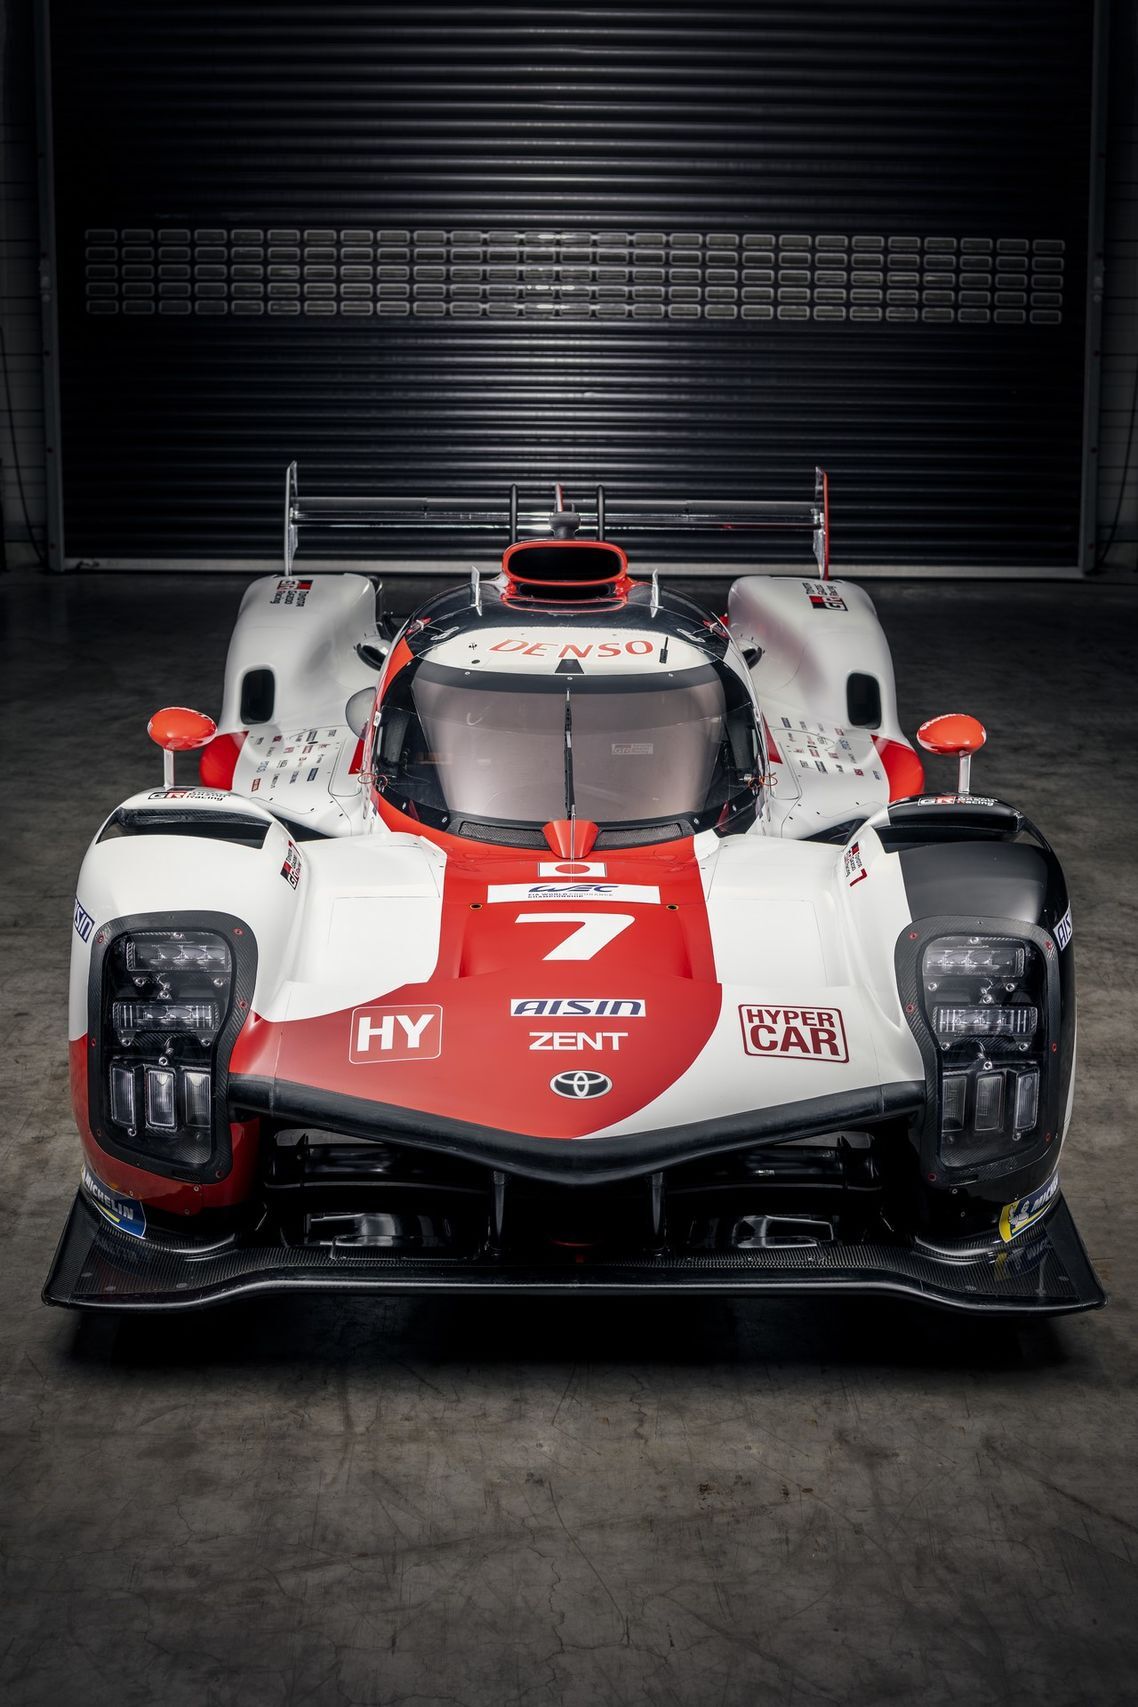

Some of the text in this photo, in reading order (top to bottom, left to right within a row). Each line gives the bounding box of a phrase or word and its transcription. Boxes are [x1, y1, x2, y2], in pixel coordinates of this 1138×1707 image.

[489, 639, 654, 658] DENSO
[528, 884, 619, 893] WEC
[514, 912, 636, 961] 7
[513, 999, 642, 1015] AISIN
[746, 1008, 836, 1028] HYPER
[356, 1013, 435, 1052] HY
[528, 1031, 629, 1051] ZENT
[750, 1024, 841, 1056] CAR
[85, 1172, 134, 1221] MICHELIN
